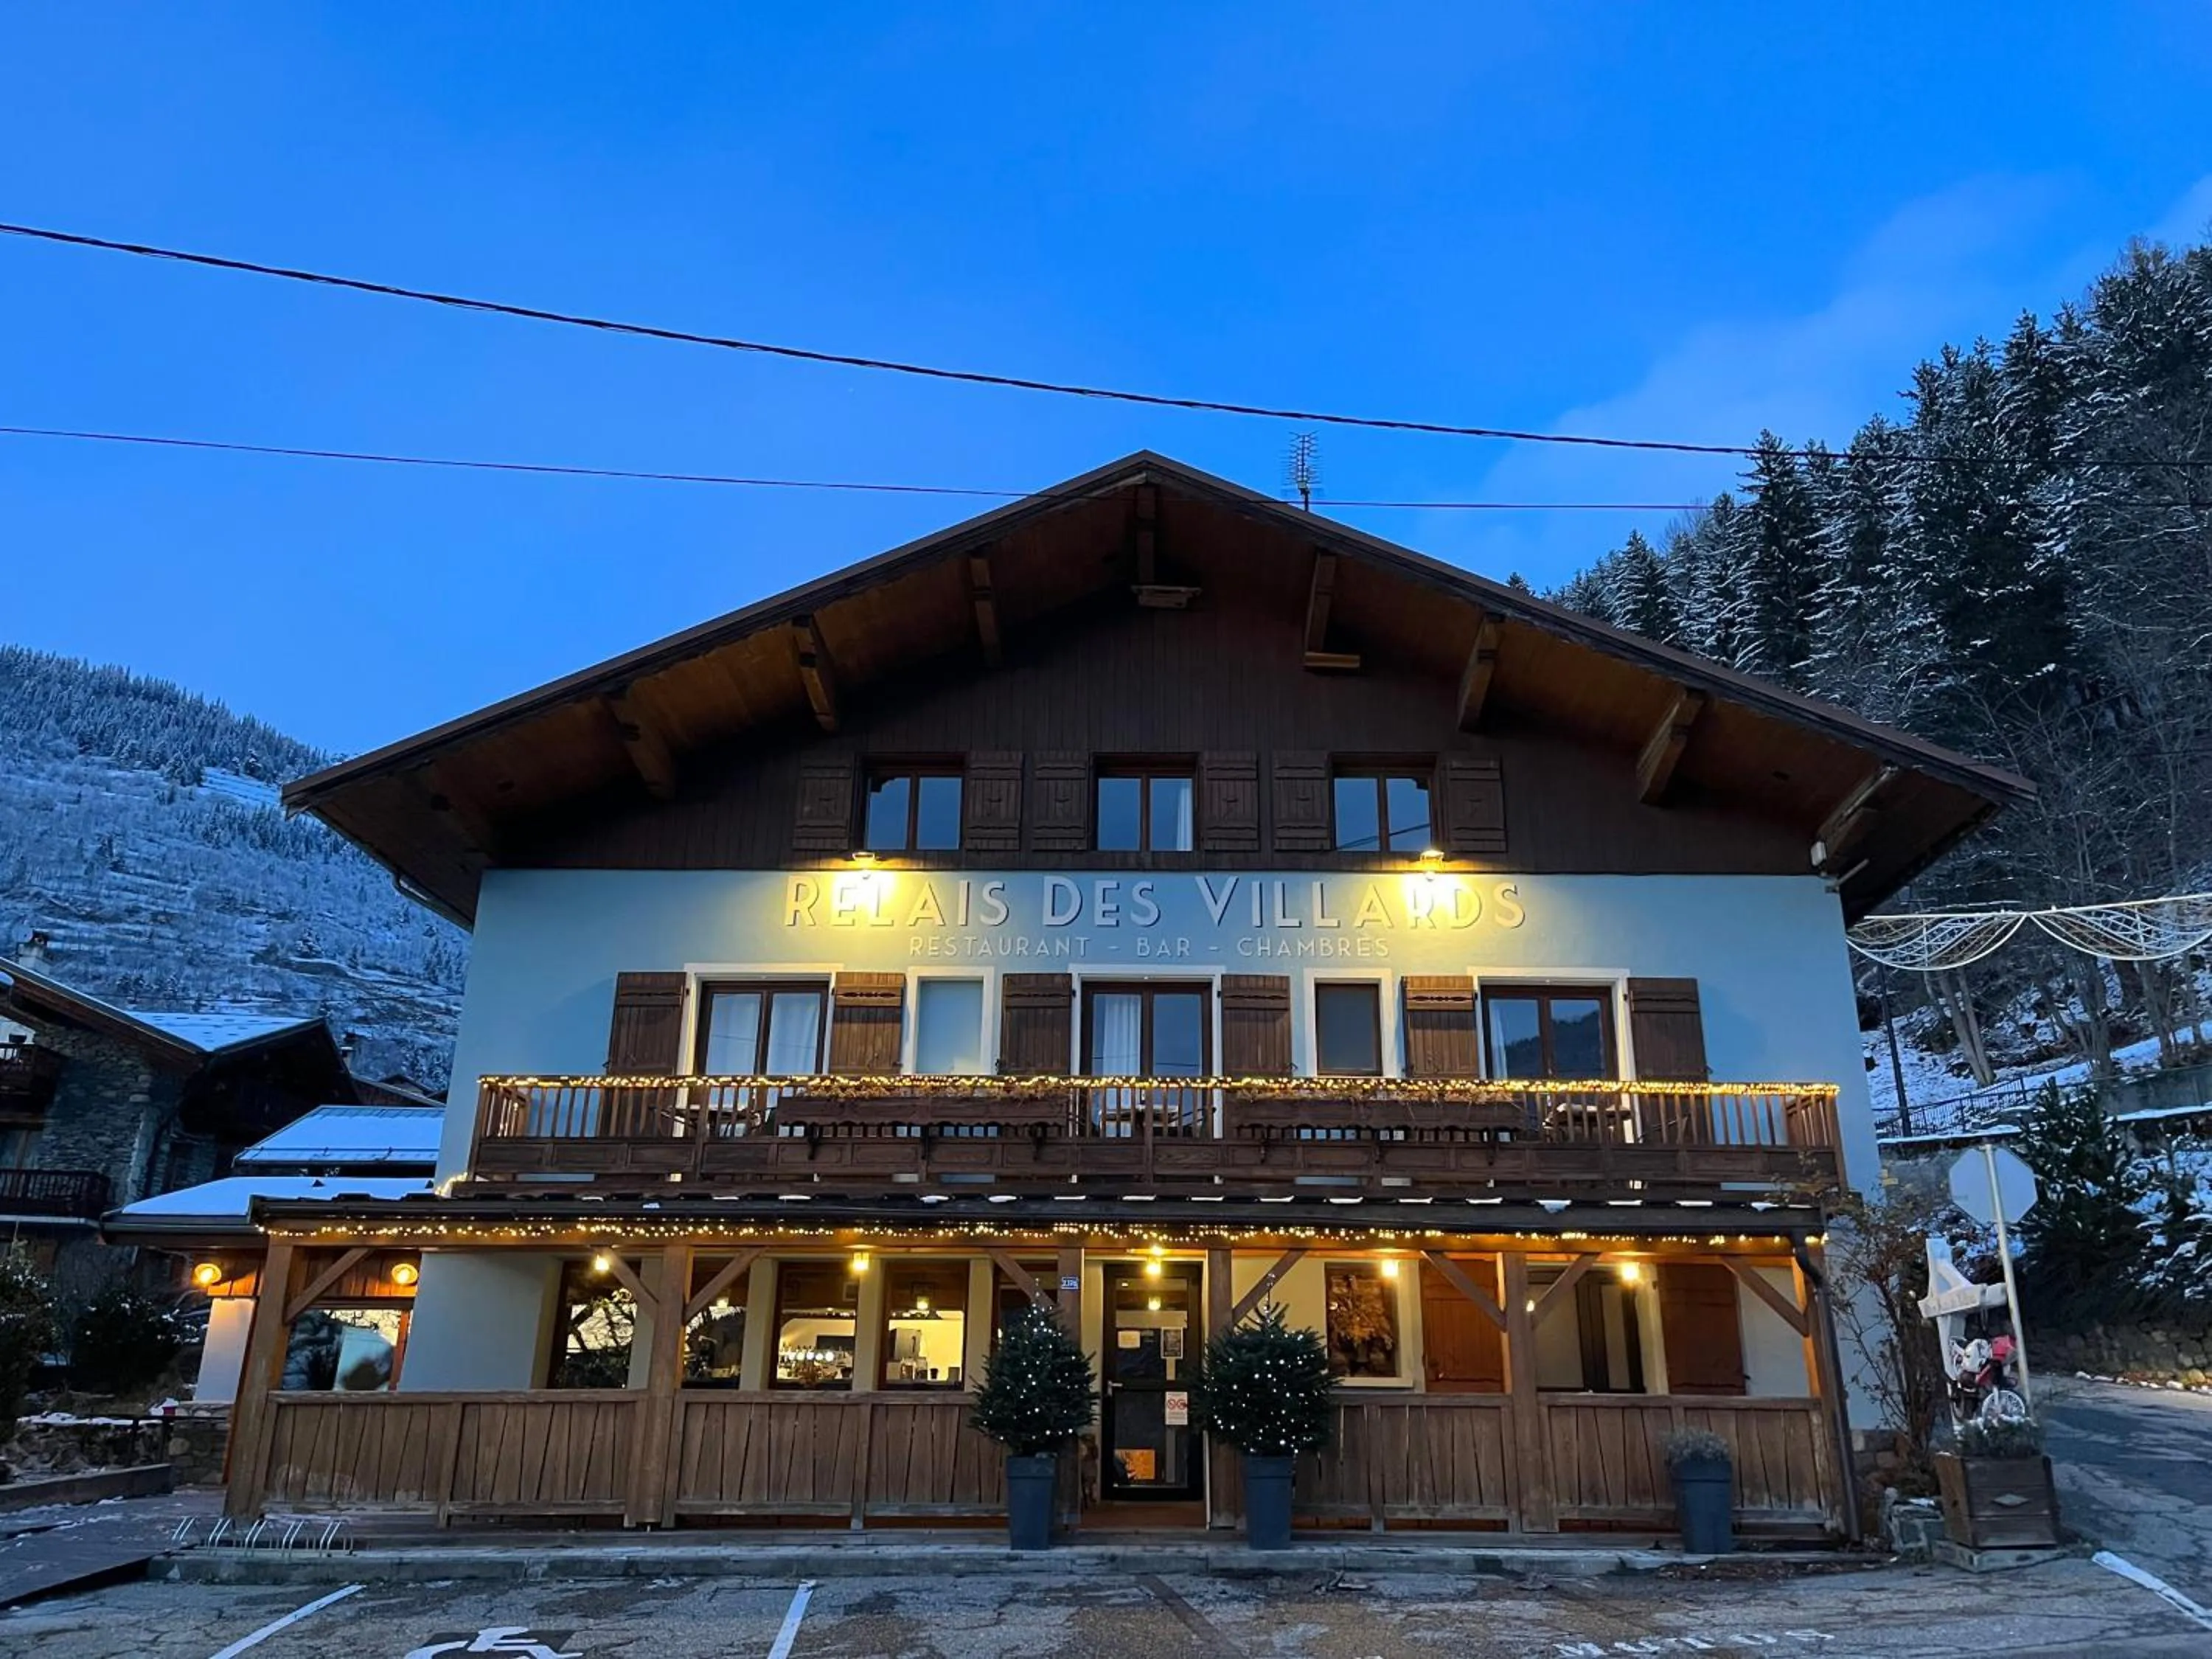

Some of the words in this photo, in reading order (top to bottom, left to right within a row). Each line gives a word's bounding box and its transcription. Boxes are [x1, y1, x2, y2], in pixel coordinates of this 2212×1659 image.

[785, 875, 1010, 927] RELAIS
[1043, 875, 1161, 927] DES
[1194, 875, 1526, 929] VILLARDS
[908, 936, 1090, 957] RESTAURANT
[1136, 936, 1191, 957] BAR
[1237, 936, 1389, 958] CHAMBRES
